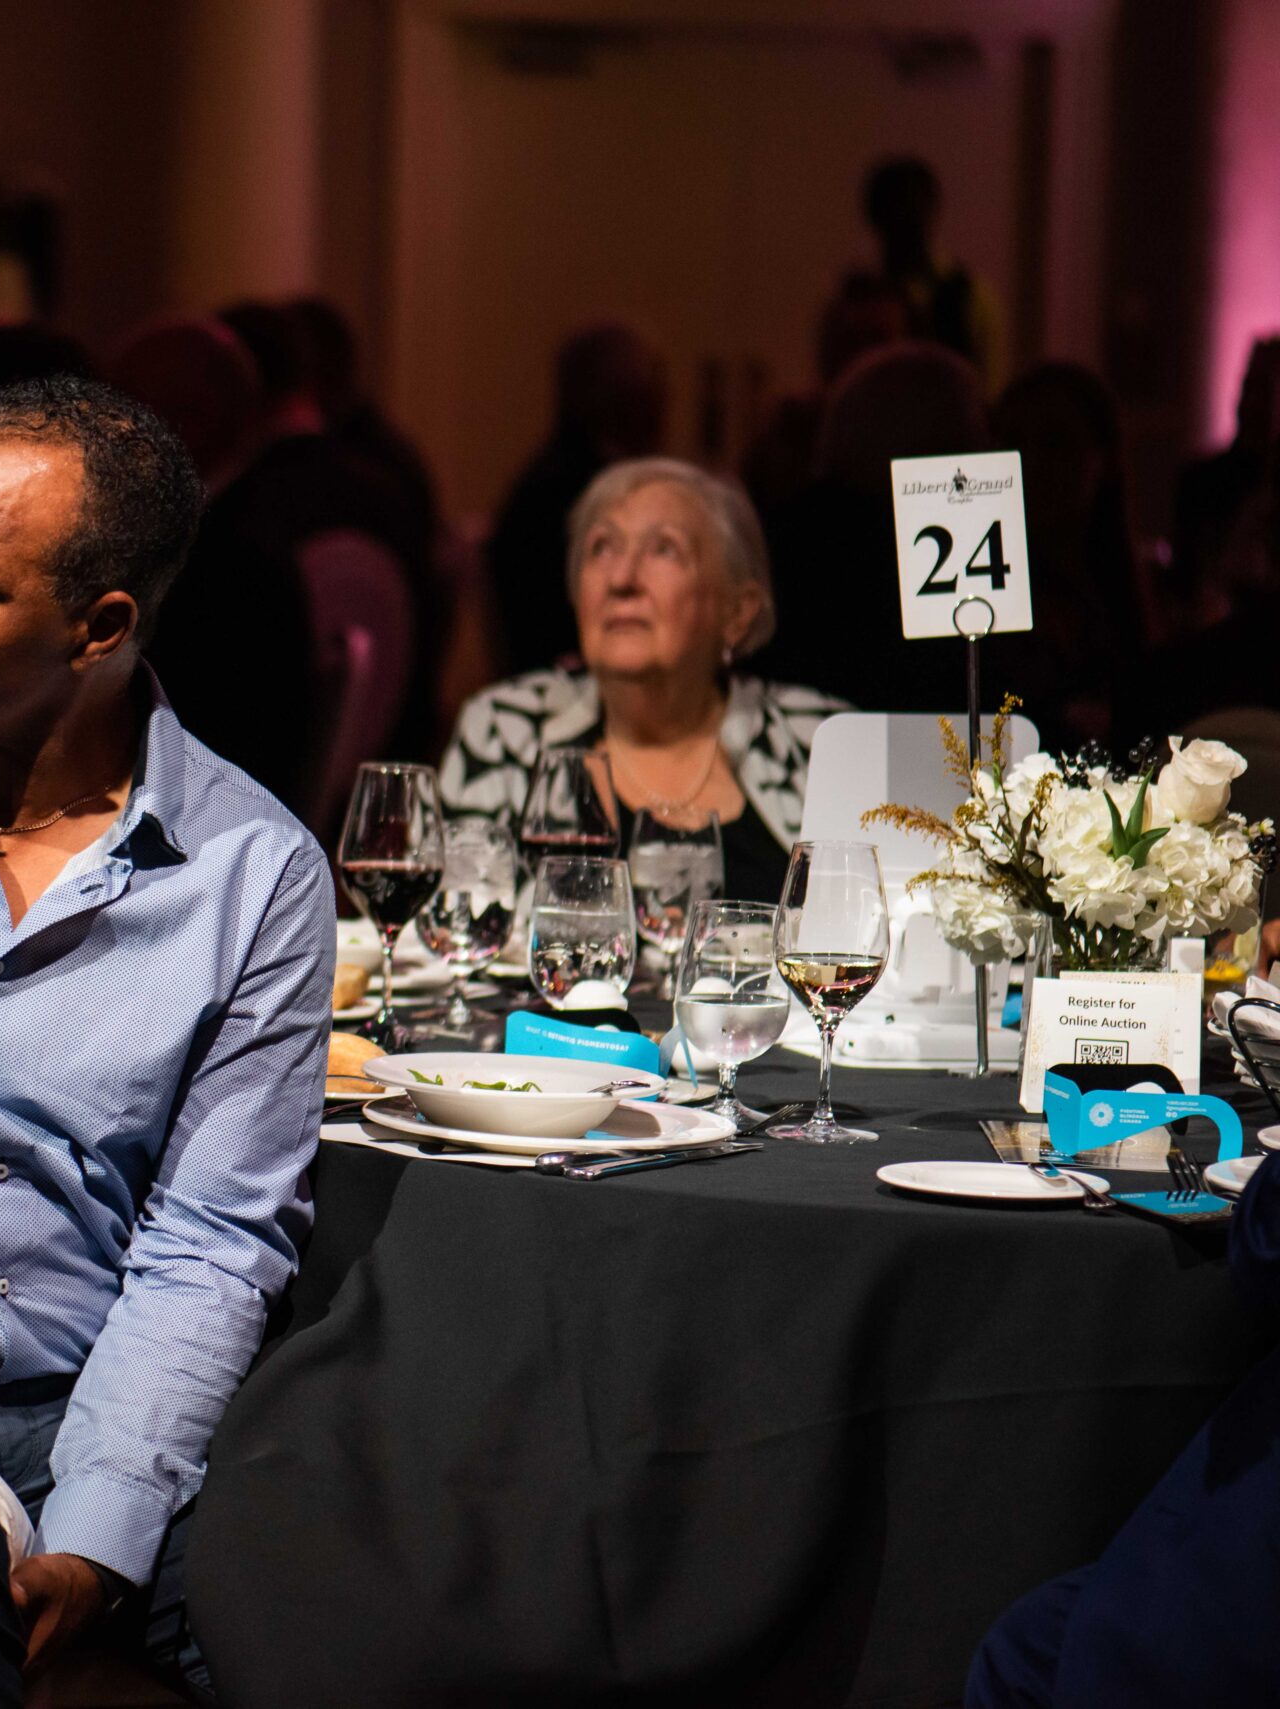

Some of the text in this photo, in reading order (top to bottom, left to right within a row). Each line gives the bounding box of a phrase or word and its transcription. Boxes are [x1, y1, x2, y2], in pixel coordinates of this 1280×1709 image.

[967, 475, 1014, 490] Grand
[913, 519, 1011, 597] 24
[1068, 996, 1137, 1010] Register for
[1059, 1015, 1147, 1030] Online Auction
[577, 1039, 629, 1051] PIGMENTOSA?
